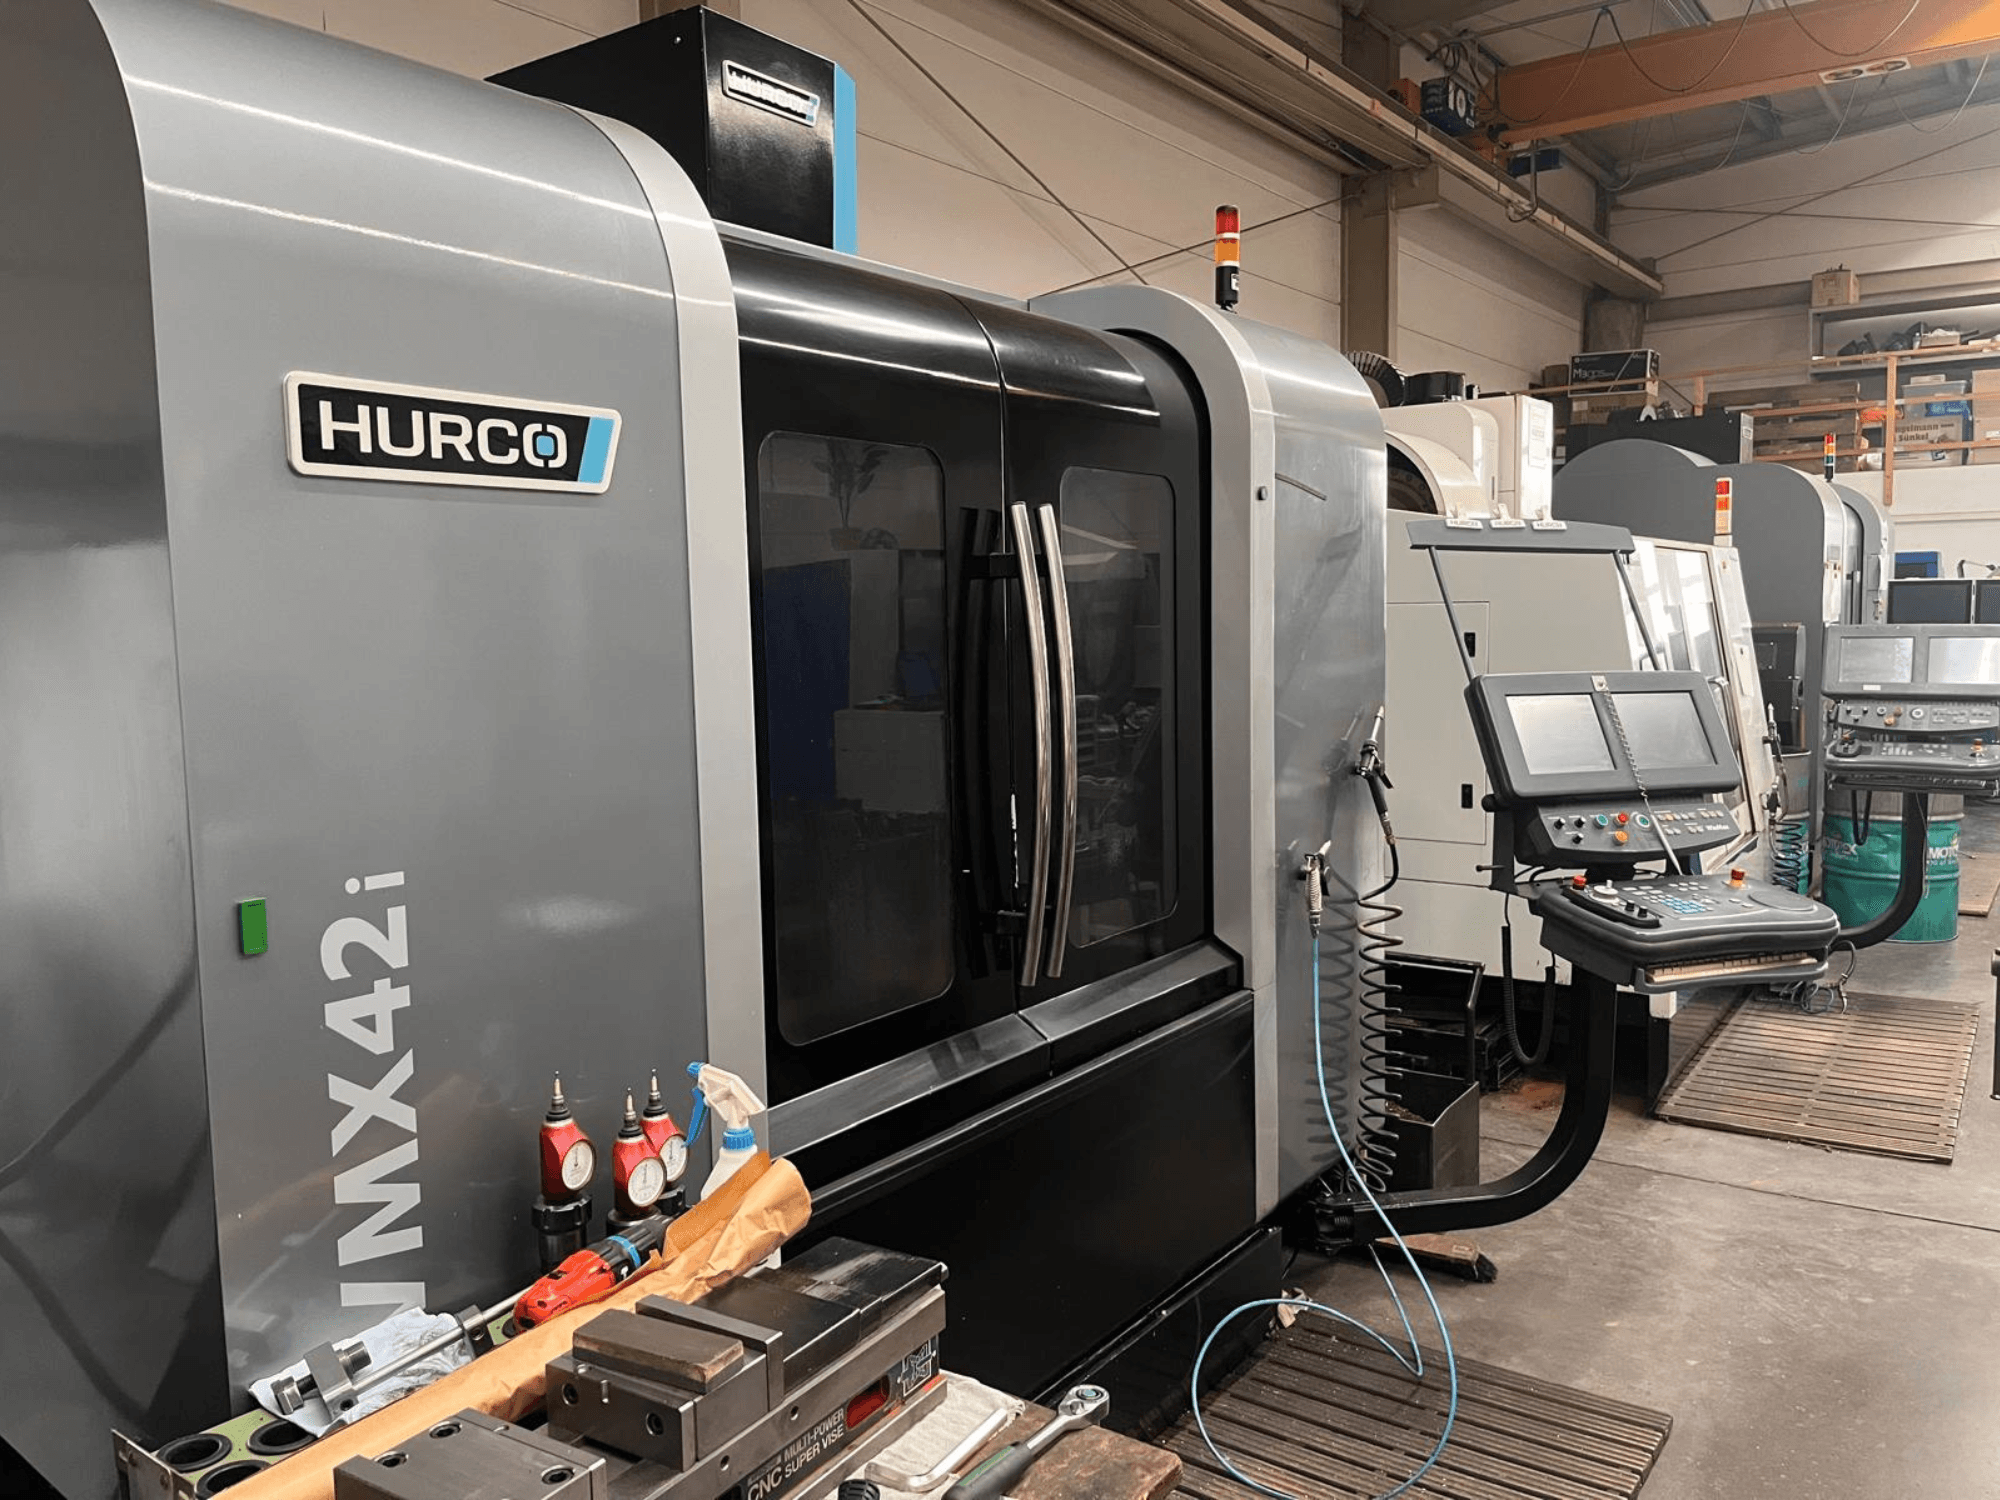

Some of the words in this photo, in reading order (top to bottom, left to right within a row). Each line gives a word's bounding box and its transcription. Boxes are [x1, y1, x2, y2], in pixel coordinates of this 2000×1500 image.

[319, 400, 568, 469] HURCO
[747, 1466, 782, 1500] CNC
[785, 1442, 820, 1479] SUPER
[822, 1424, 845, 1450] VISE
[784, 1408, 844, 1463] MULTI-POWER
